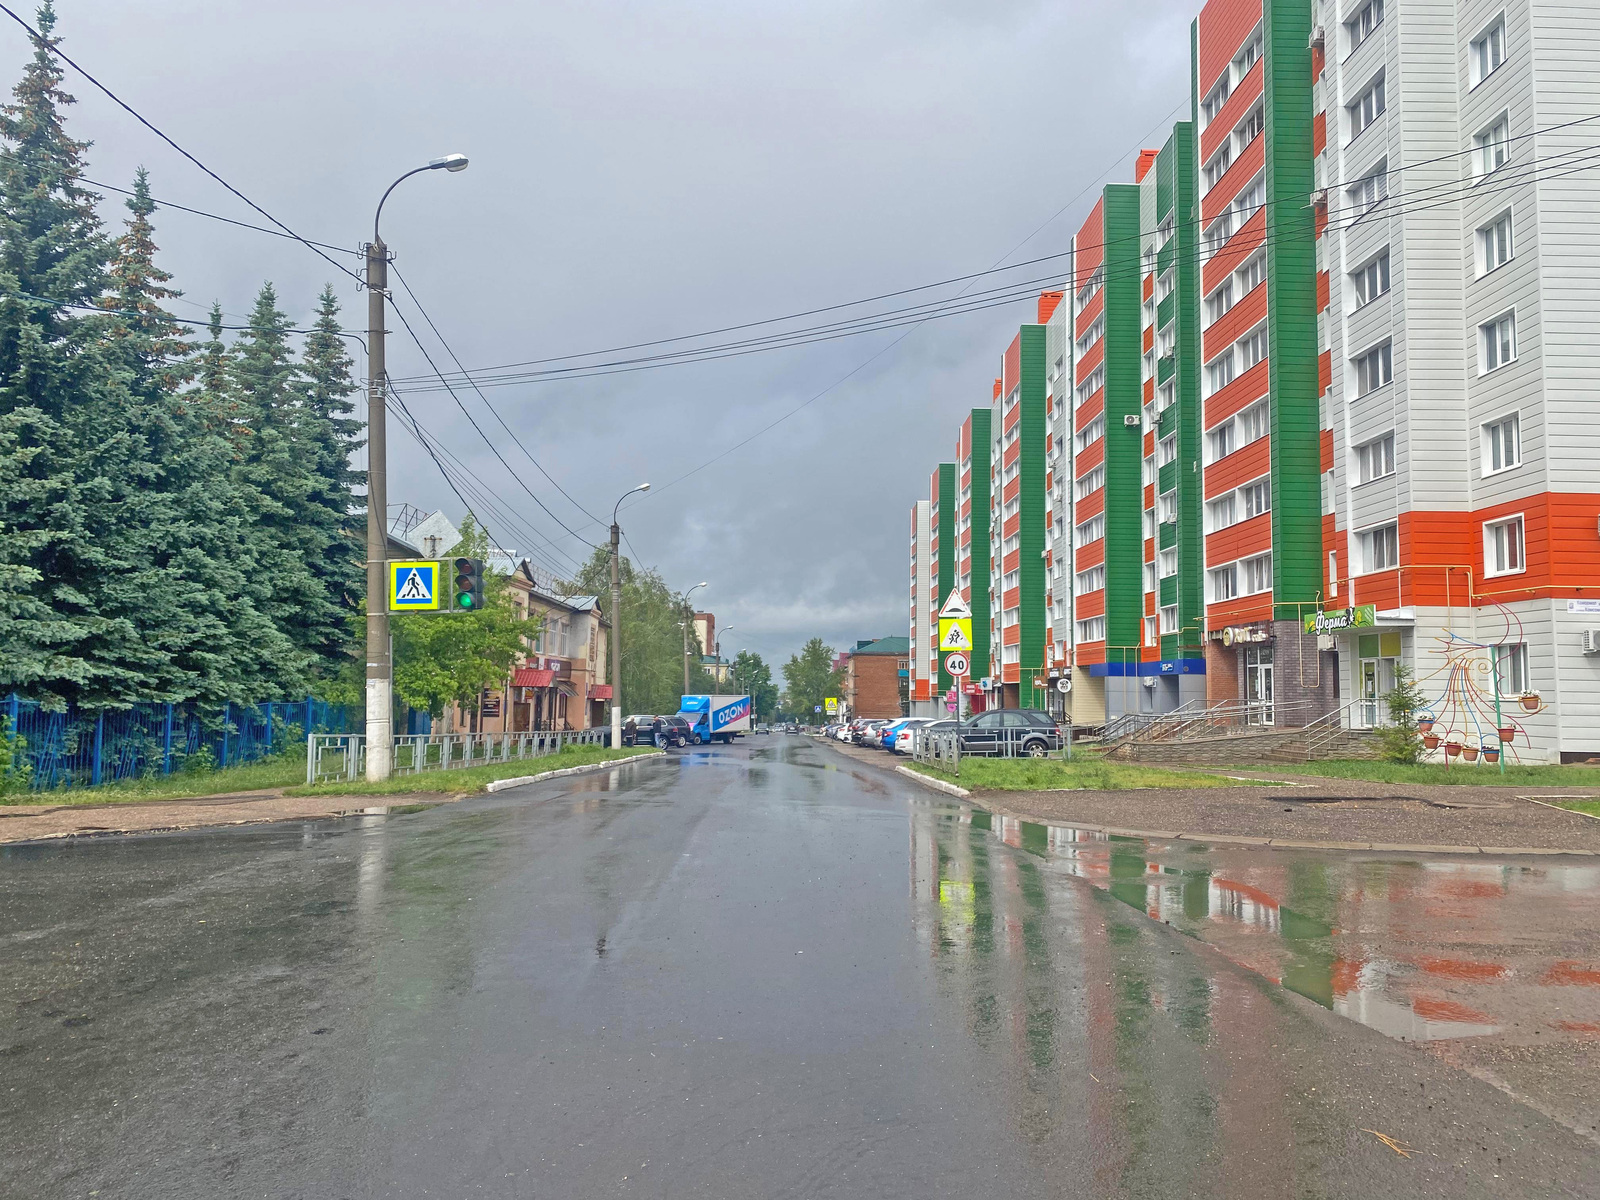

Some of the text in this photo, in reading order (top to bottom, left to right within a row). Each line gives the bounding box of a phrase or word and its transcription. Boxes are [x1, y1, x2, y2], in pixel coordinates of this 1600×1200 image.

[1316, 610, 1348, 636] Ферма
[950, 660, 964, 670] 40
[718, 703, 743, 724] OZON
